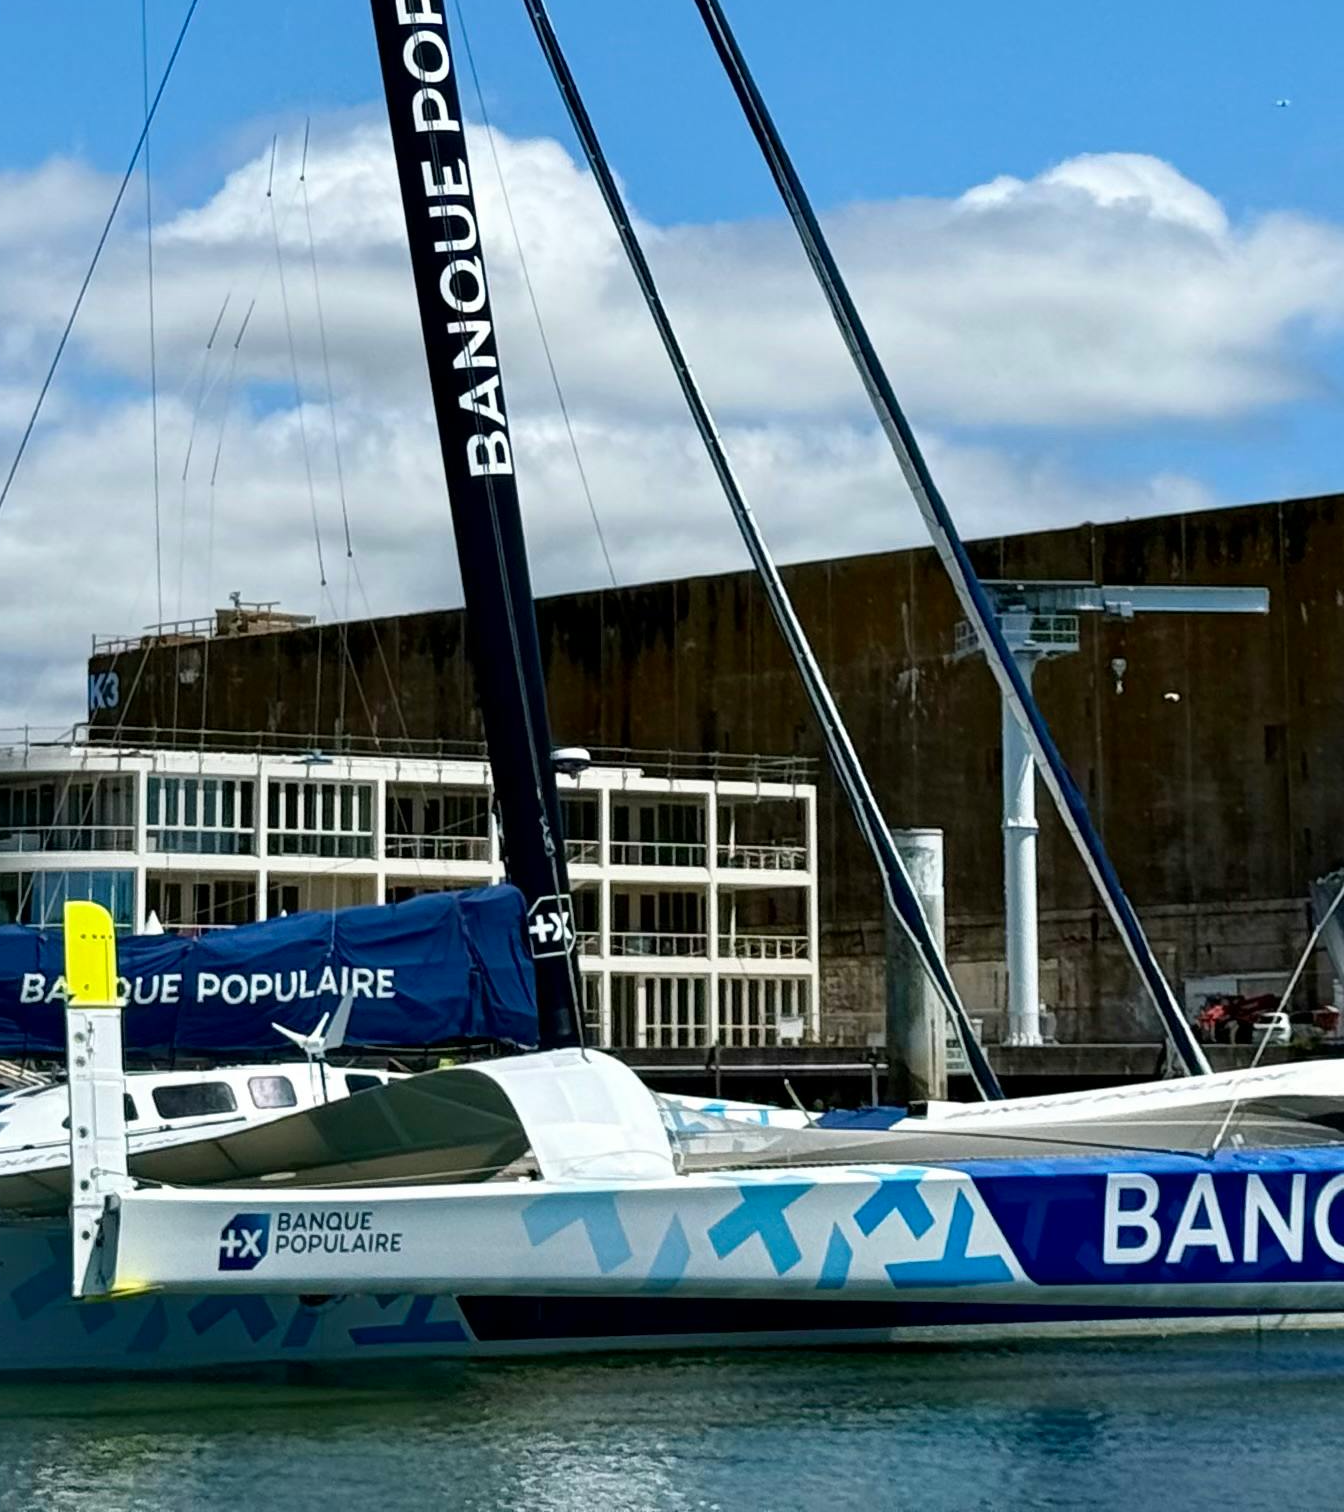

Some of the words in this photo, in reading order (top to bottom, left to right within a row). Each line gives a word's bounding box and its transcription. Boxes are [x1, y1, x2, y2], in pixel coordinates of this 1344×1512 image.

[422, 158, 513, 477] BANQUE
[90, 672, 119, 711] K3
[196, 966, 396, 1005] POPULAIRE
[277, 1212, 373, 1231] BANQUE
[275, 1233, 403, 1254] POPULAIRE
